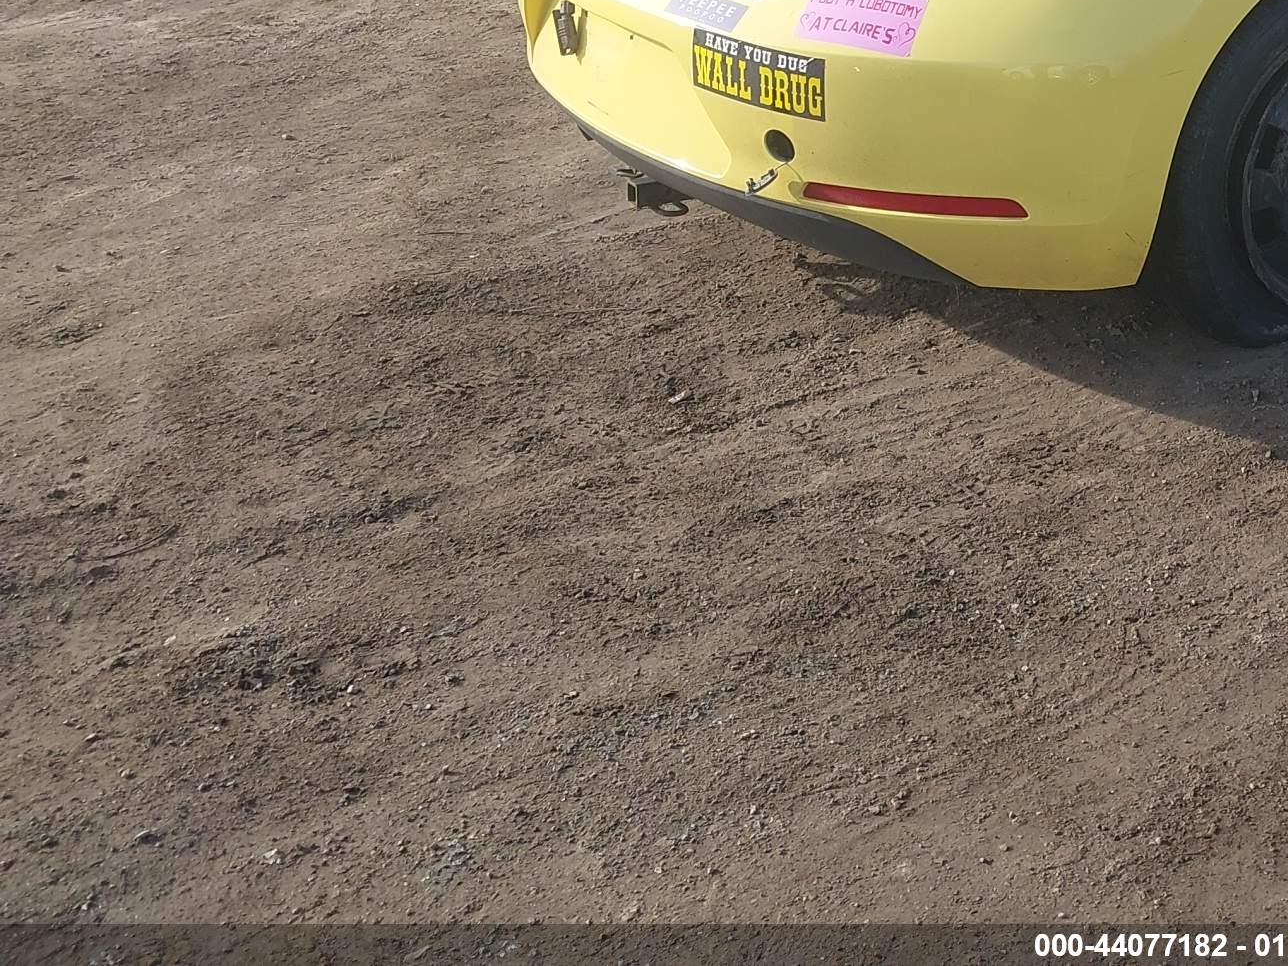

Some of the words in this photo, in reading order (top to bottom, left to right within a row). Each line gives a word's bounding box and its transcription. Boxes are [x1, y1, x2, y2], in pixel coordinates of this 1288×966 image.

[809, 16, 831, 33] AT
[832, 18, 896, 45] CLAIRE'S
[703, 31, 739, 55] HAVE
[743, 44, 772, 65] YOU
[692, 43, 752, 101] WALL
[758, 66, 823, 117] DRUG
